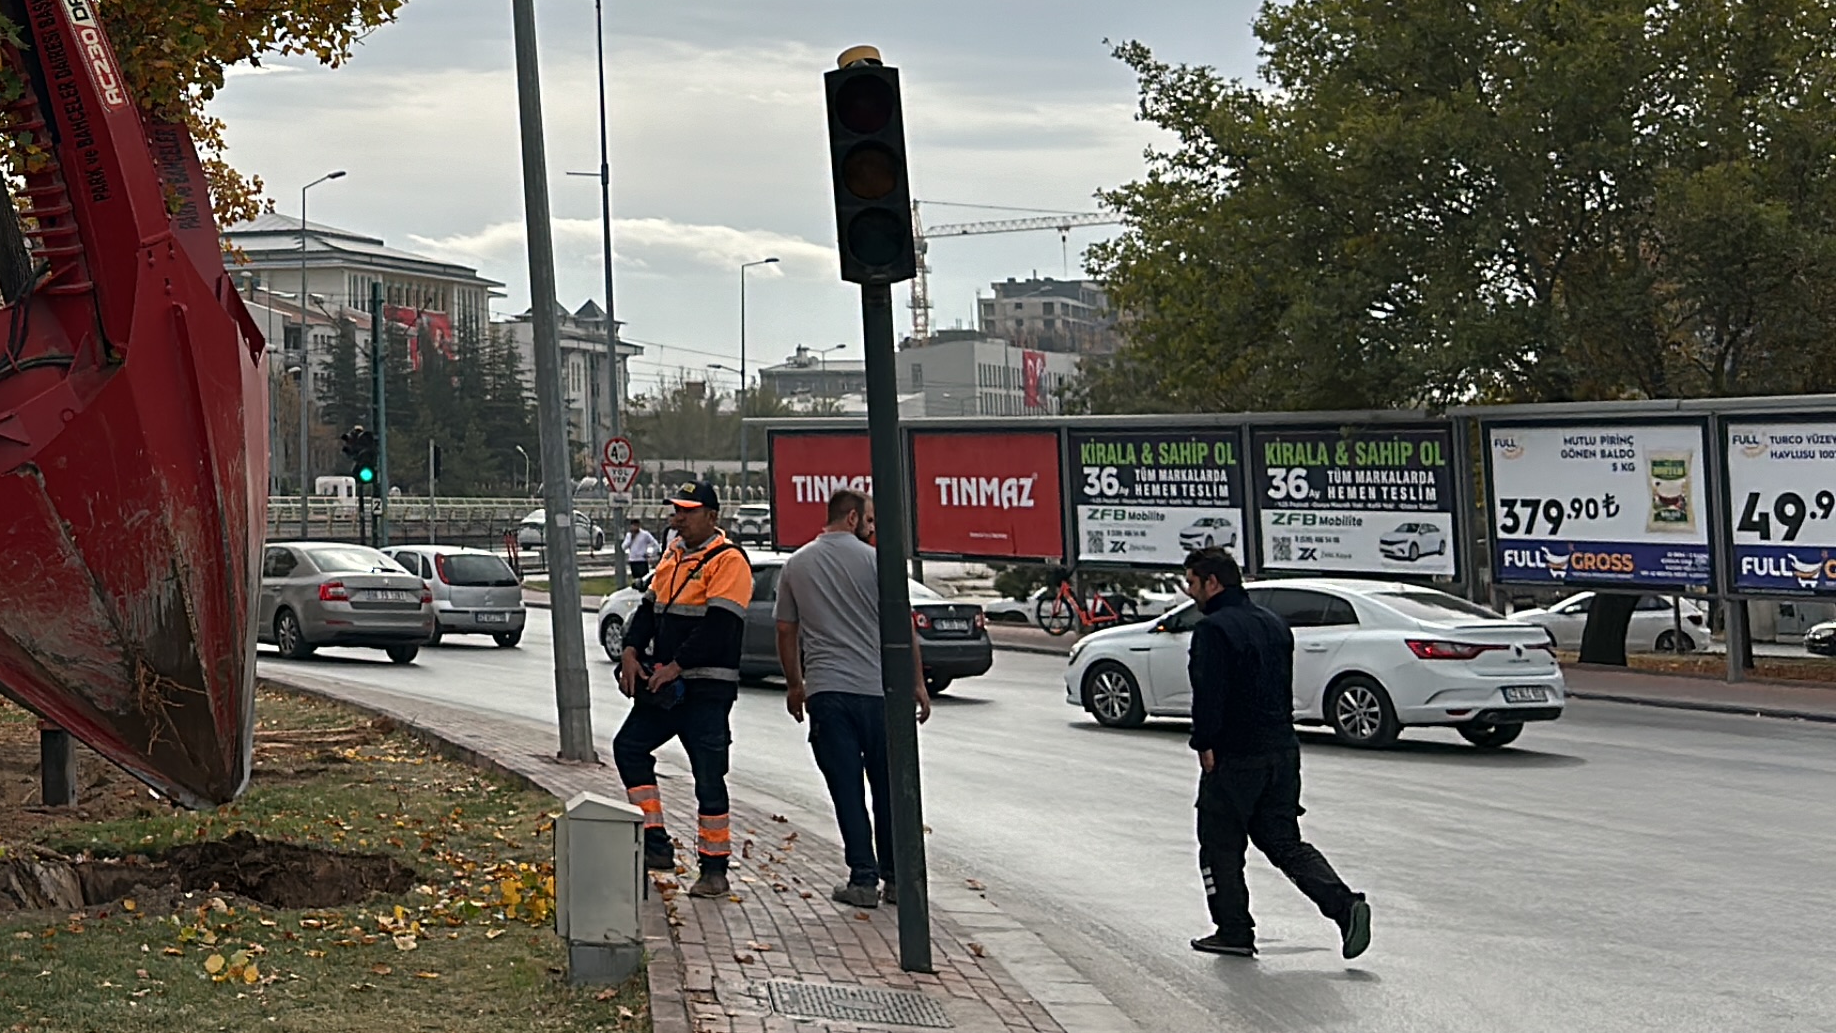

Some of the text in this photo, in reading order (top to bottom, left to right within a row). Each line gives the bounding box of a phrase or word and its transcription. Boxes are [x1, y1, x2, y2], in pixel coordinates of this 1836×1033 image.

[87, 168, 112, 203] PARK
[1564, 433, 1635, 447] MUTLU PİRİNÇ
[1081, 437, 1236, 465] KİRALA & SAHİP OL
[1264, 436, 1445, 466] KİRALA & SAHİP OL
[1560, 447, 1635, 459] GÖNEN BALDO
[1134, 467, 1228, 482] TÜM MARKALARDA
[1327, 467, 1436, 485] TÜM MARKALARDA
[1621, 463, 1635, 472] KG
[1083, 467, 1120, 496] 36
[1134, 482, 1230, 498] HEMEN TESLİM
[1267, 467, 1321, 499] 36 Ay
[935, 476, 1034, 510] TINMAZ
[1327, 484, 1437, 501] HEMEN TESLİM
[374, 500, 381, 511] 2
[1087, 508, 1126, 521] ZFB
[1271, 512, 1363, 527] ZFB Mobilite
[1503, 549, 1546, 568] FULL
[1571, 552, 1634, 572] GROSS
[1741, 556, 1793, 577] FULL
